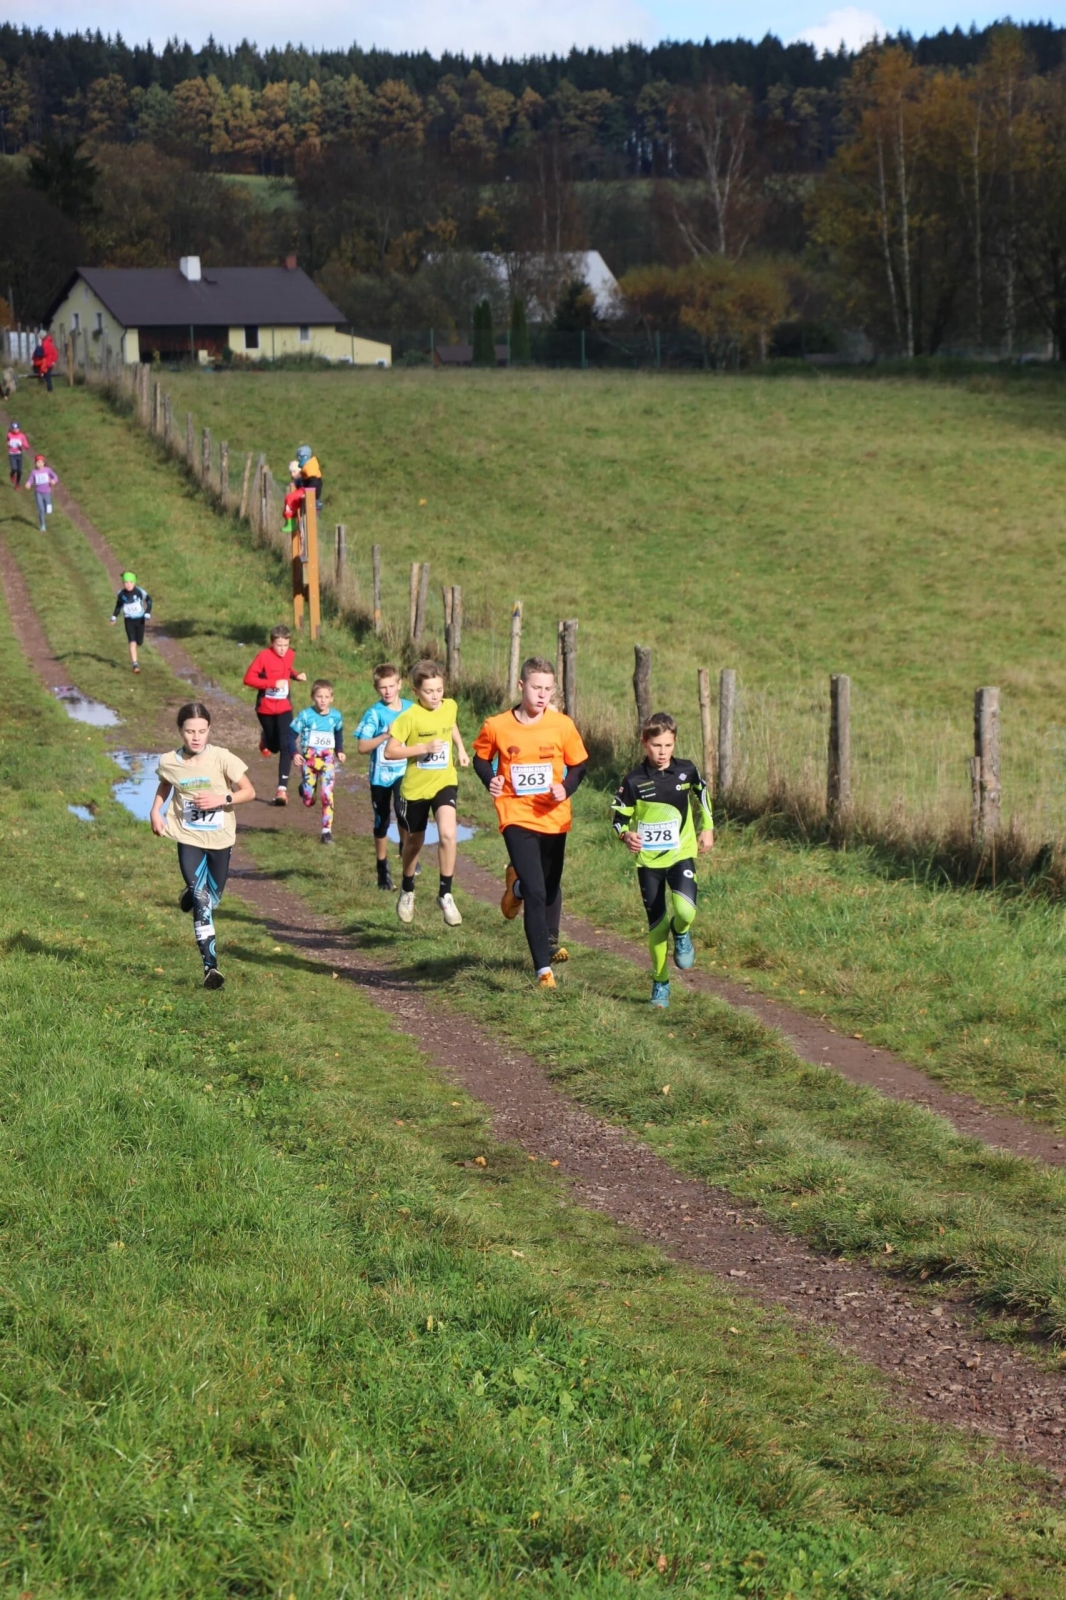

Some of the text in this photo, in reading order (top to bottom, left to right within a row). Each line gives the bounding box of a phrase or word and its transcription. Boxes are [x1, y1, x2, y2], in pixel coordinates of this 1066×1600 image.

[314, 737, 331, 746] 368
[423, 751, 445, 762] 264
[518, 773, 545, 786] 263
[191, 809, 216, 822] 317
[644, 830, 672, 842] 378
